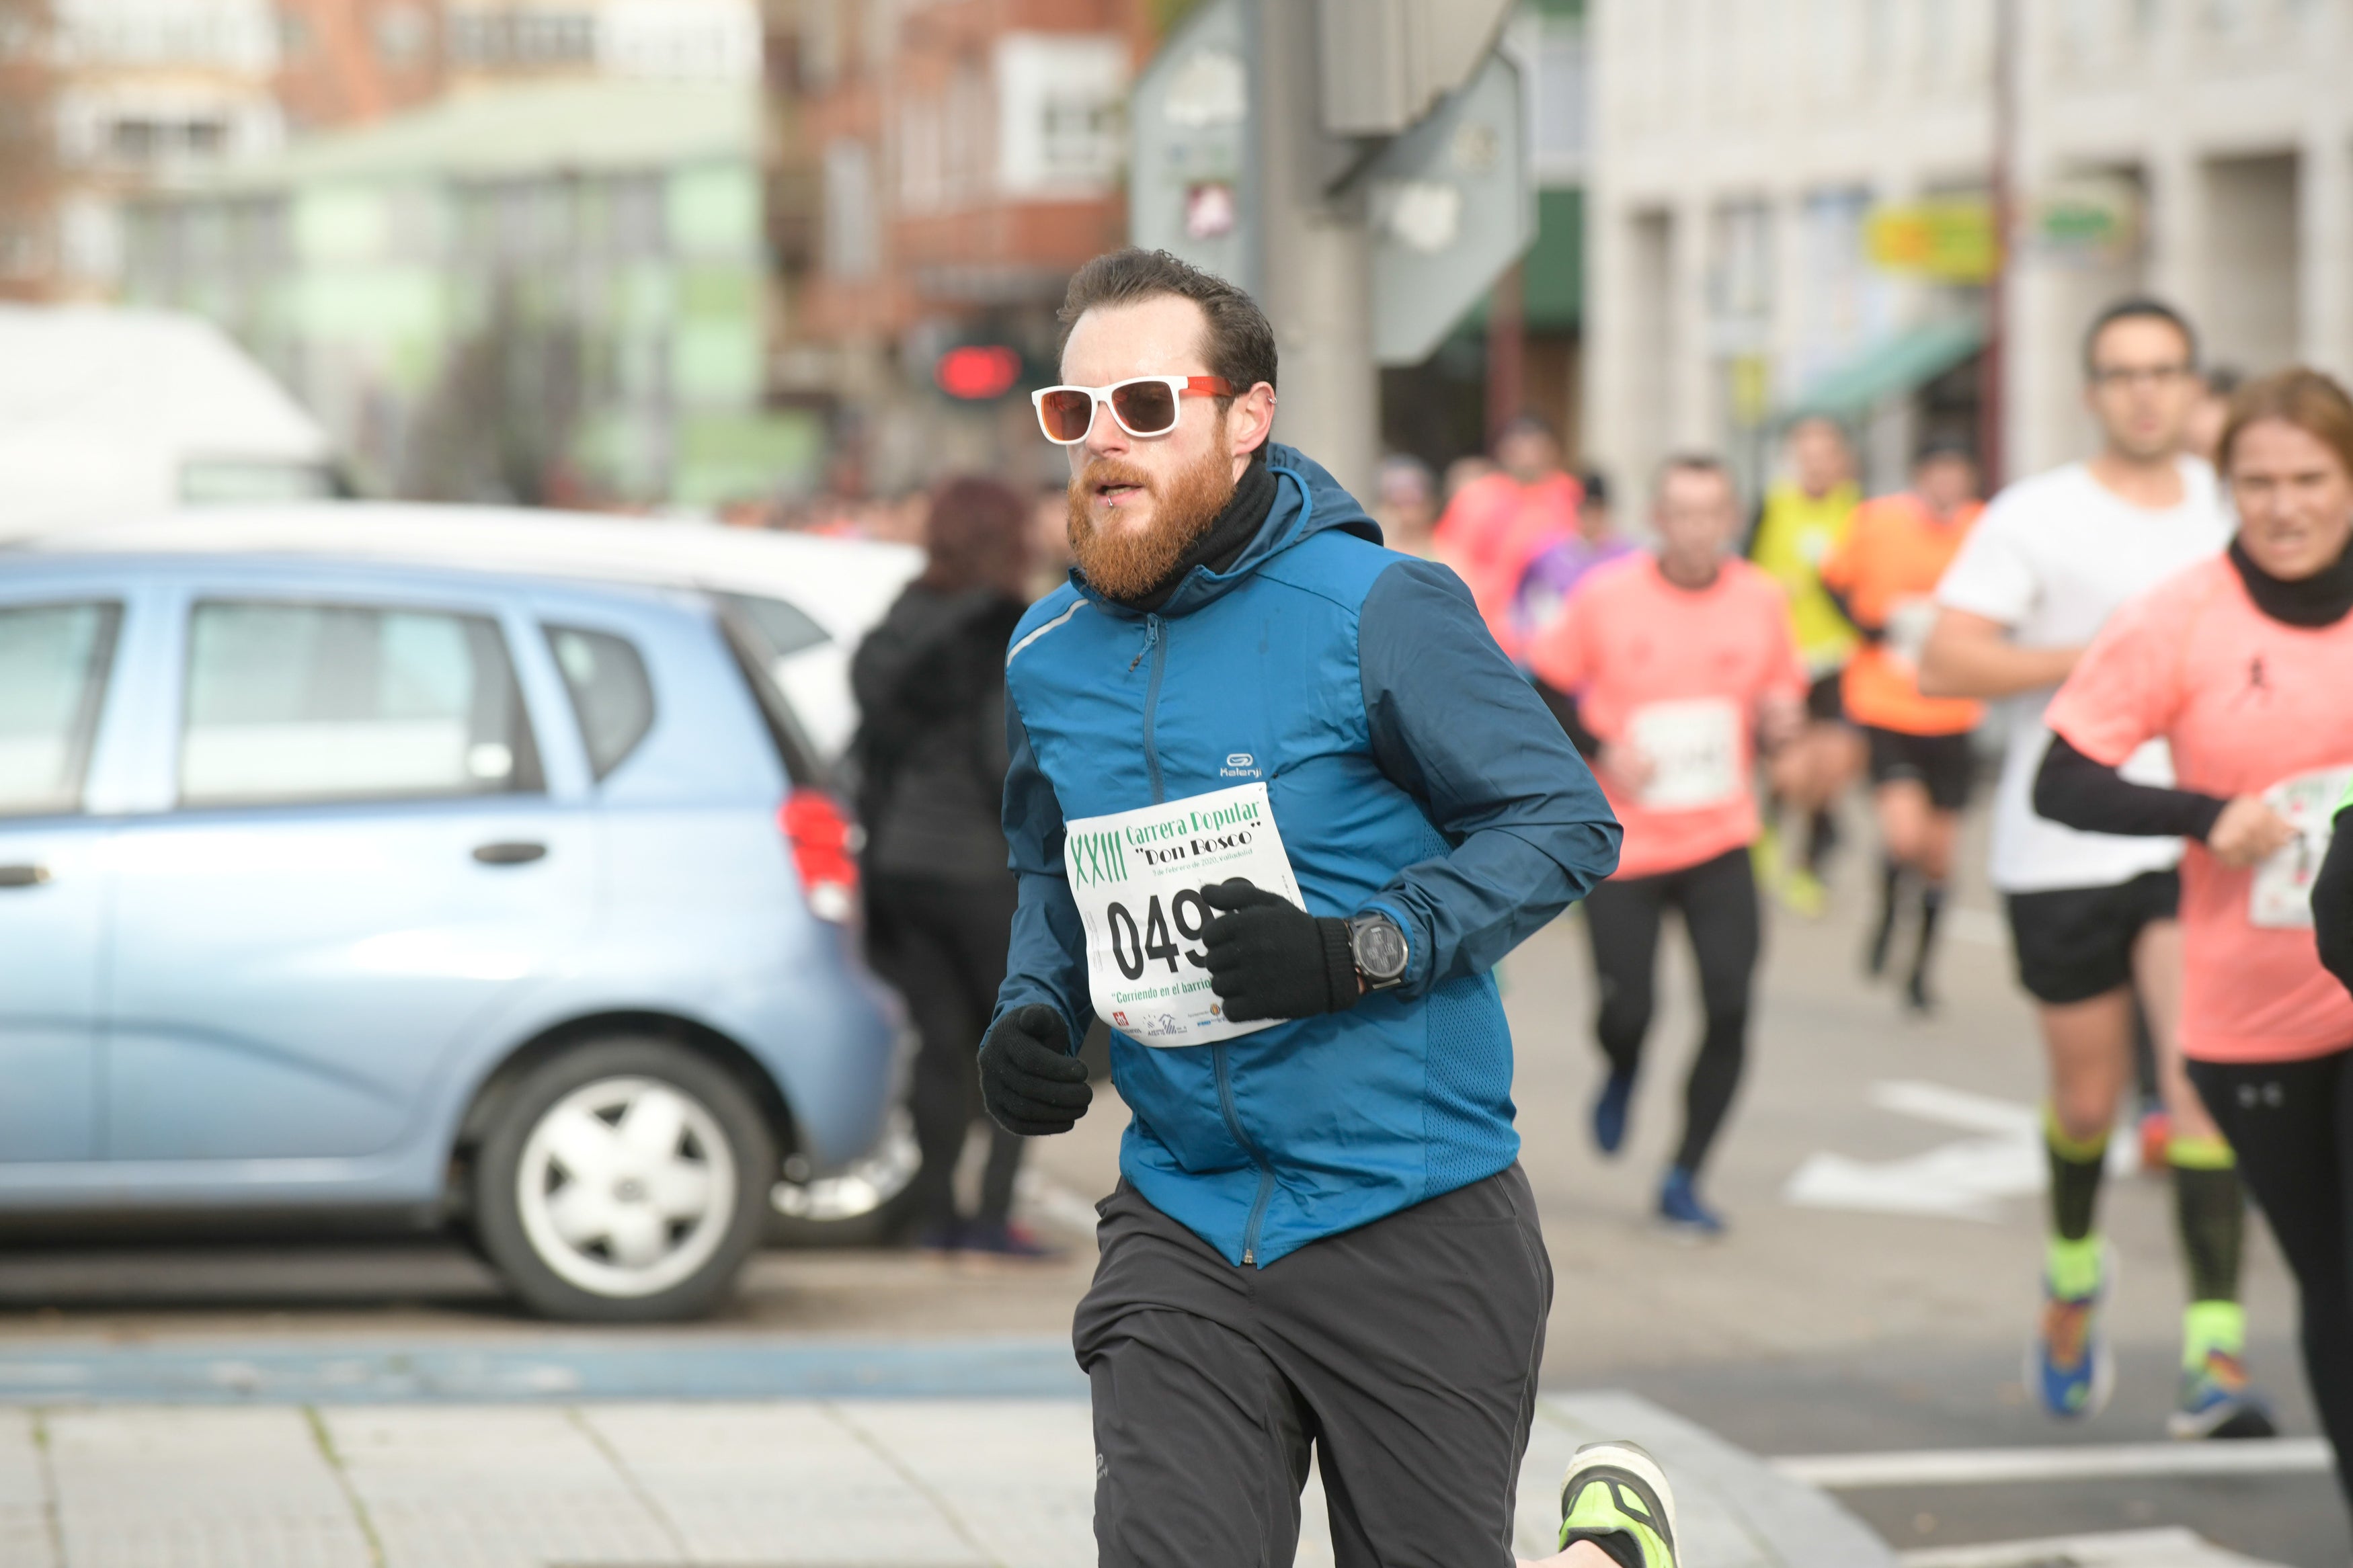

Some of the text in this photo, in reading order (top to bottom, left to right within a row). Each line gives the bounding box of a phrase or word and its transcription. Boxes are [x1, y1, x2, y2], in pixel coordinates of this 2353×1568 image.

[1220, 768, 1262, 778] Kalenji
[1070, 802, 1259, 891] XXIII Carrera Popular
[1166, 864, 1191, 874] febrero
[1193, 861, 1200, 869] de
[1220, 848, 1253, 862] Valladolid
[1107, 876, 1257, 980] 049
[1160, 987, 1170, 997] en
[1172, 983, 1180, 995] el
